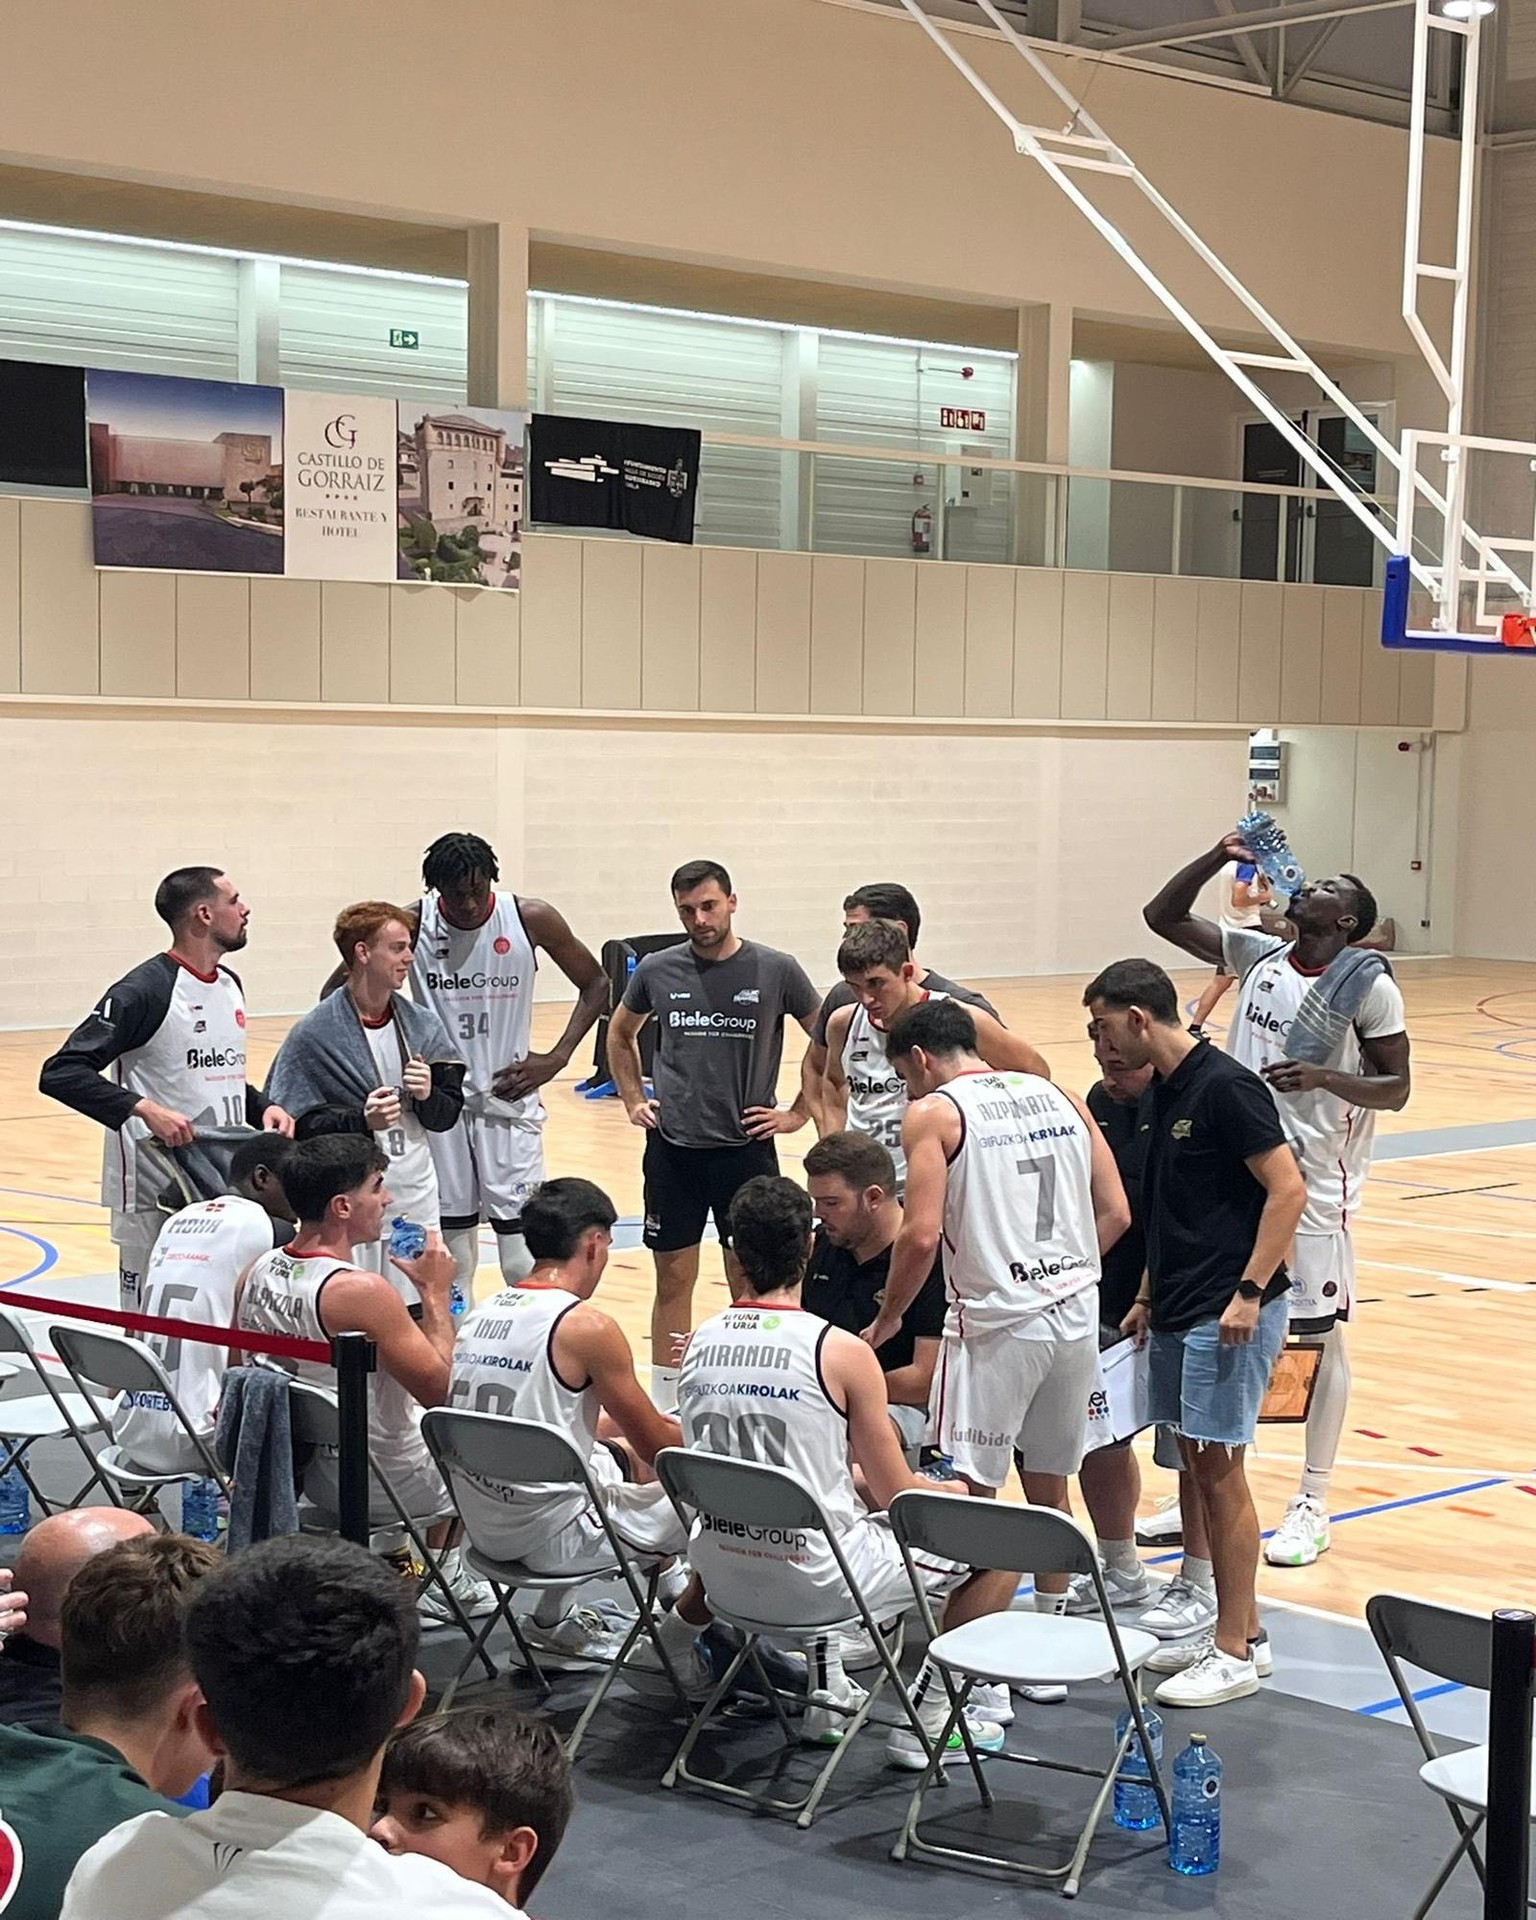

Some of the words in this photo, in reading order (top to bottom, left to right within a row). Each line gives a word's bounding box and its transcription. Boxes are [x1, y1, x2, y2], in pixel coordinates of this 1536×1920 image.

[297, 452, 362, 469] CASTILLO
[367, 457, 385, 471] DE
[297, 469, 385, 492] GORRAIZ
[322, 526, 358, 537] HOTEL
[427, 973, 519, 990] BieleGroup
[459, 1012, 489, 1040] 34
[669, 1010, 757, 1032] BieleGroup
[388, 1129, 406, 1156] 8
[1016, 1153, 1056, 1242] 7
[473, 1318, 514, 1341] INDA
[695, 1344, 792, 1371] MIRANDA
